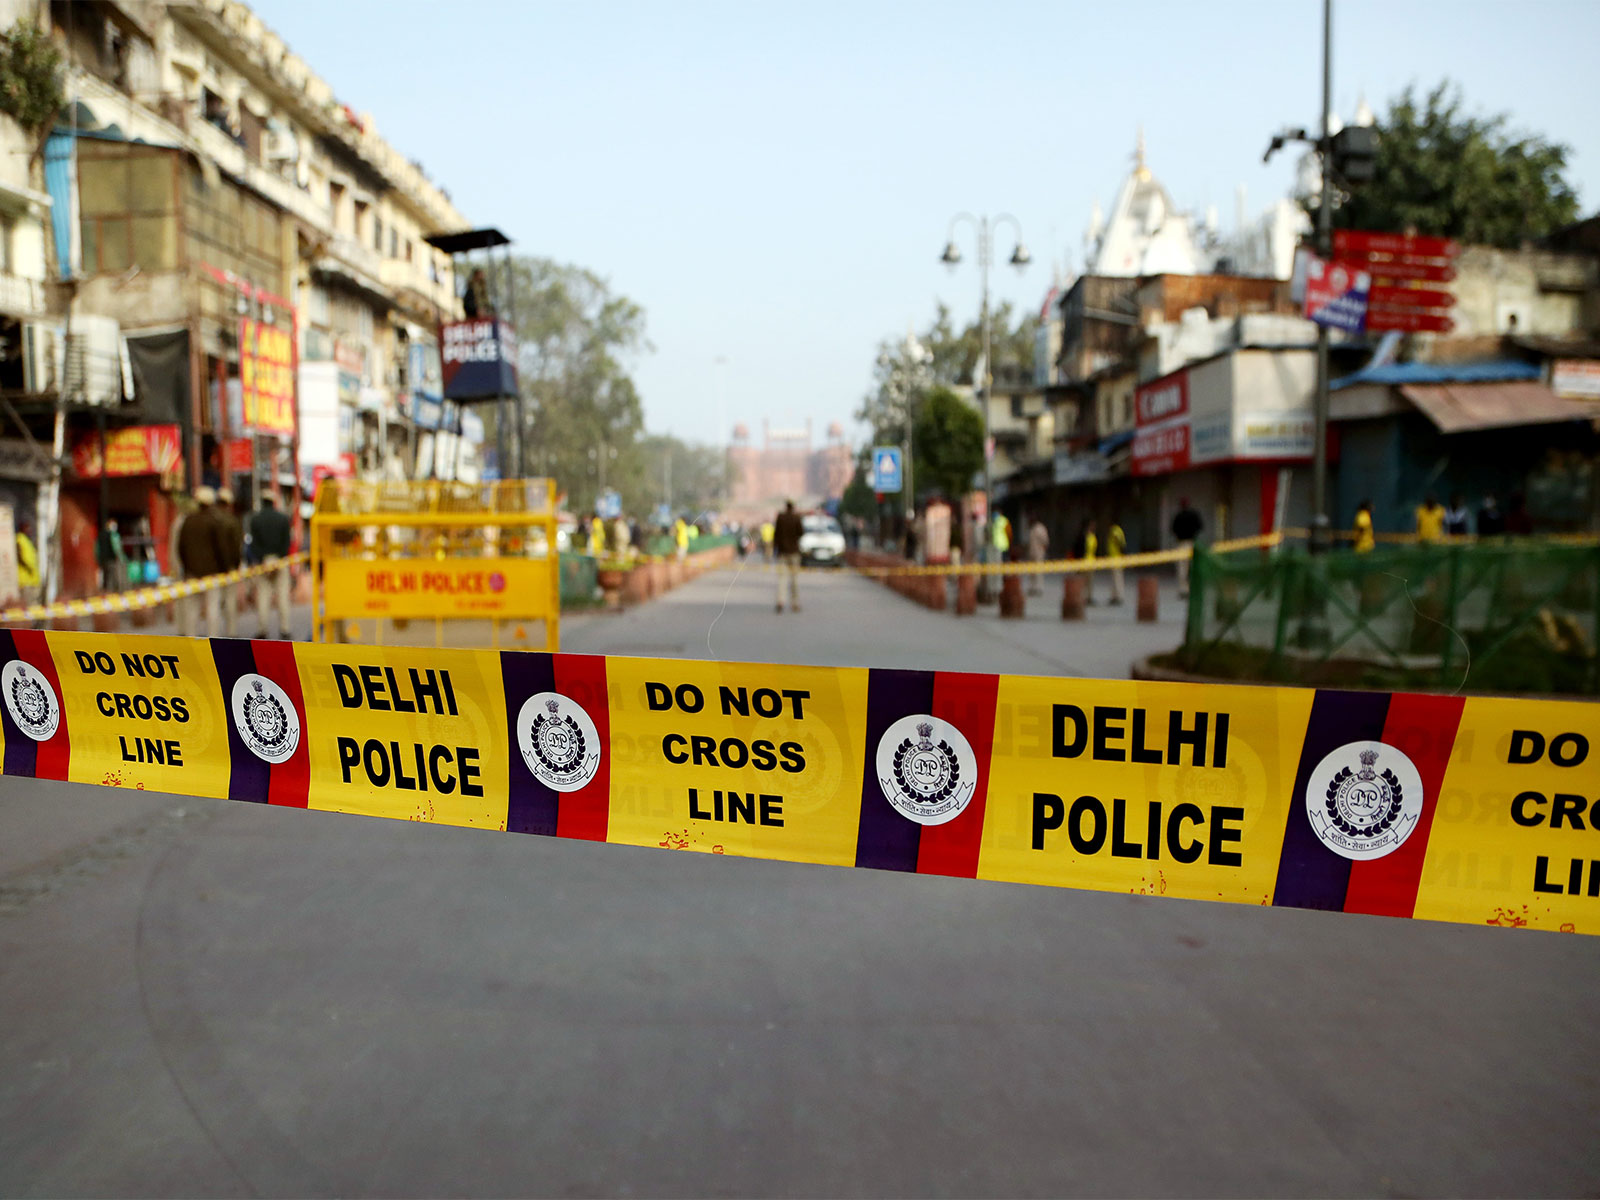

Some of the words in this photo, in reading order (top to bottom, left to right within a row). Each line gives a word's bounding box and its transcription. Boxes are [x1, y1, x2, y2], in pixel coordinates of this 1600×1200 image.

[443, 323, 493, 344] DELHI
[443, 340, 497, 363] POLICE
[367, 571, 416, 594] DELHI
[421, 571, 486, 595] POLICE
[74, 650, 116, 676] DO
[120, 653, 180, 680] NOT
[97, 691, 190, 723] CROSS
[331, 663, 458, 716] DELHI
[645, 681, 705, 714] DO
[719, 686, 811, 720] NOT
[119, 736, 184, 767] LINE
[663, 733, 806, 773] CROSS
[1052, 703, 1230, 769] DELHI
[1507, 729, 1590, 768] DO
[337, 736, 484, 798] POLICE
[688, 788, 785, 828] LINE
[1510, 791, 1600, 831] CR
[1031, 792, 1245, 867] POLICE
